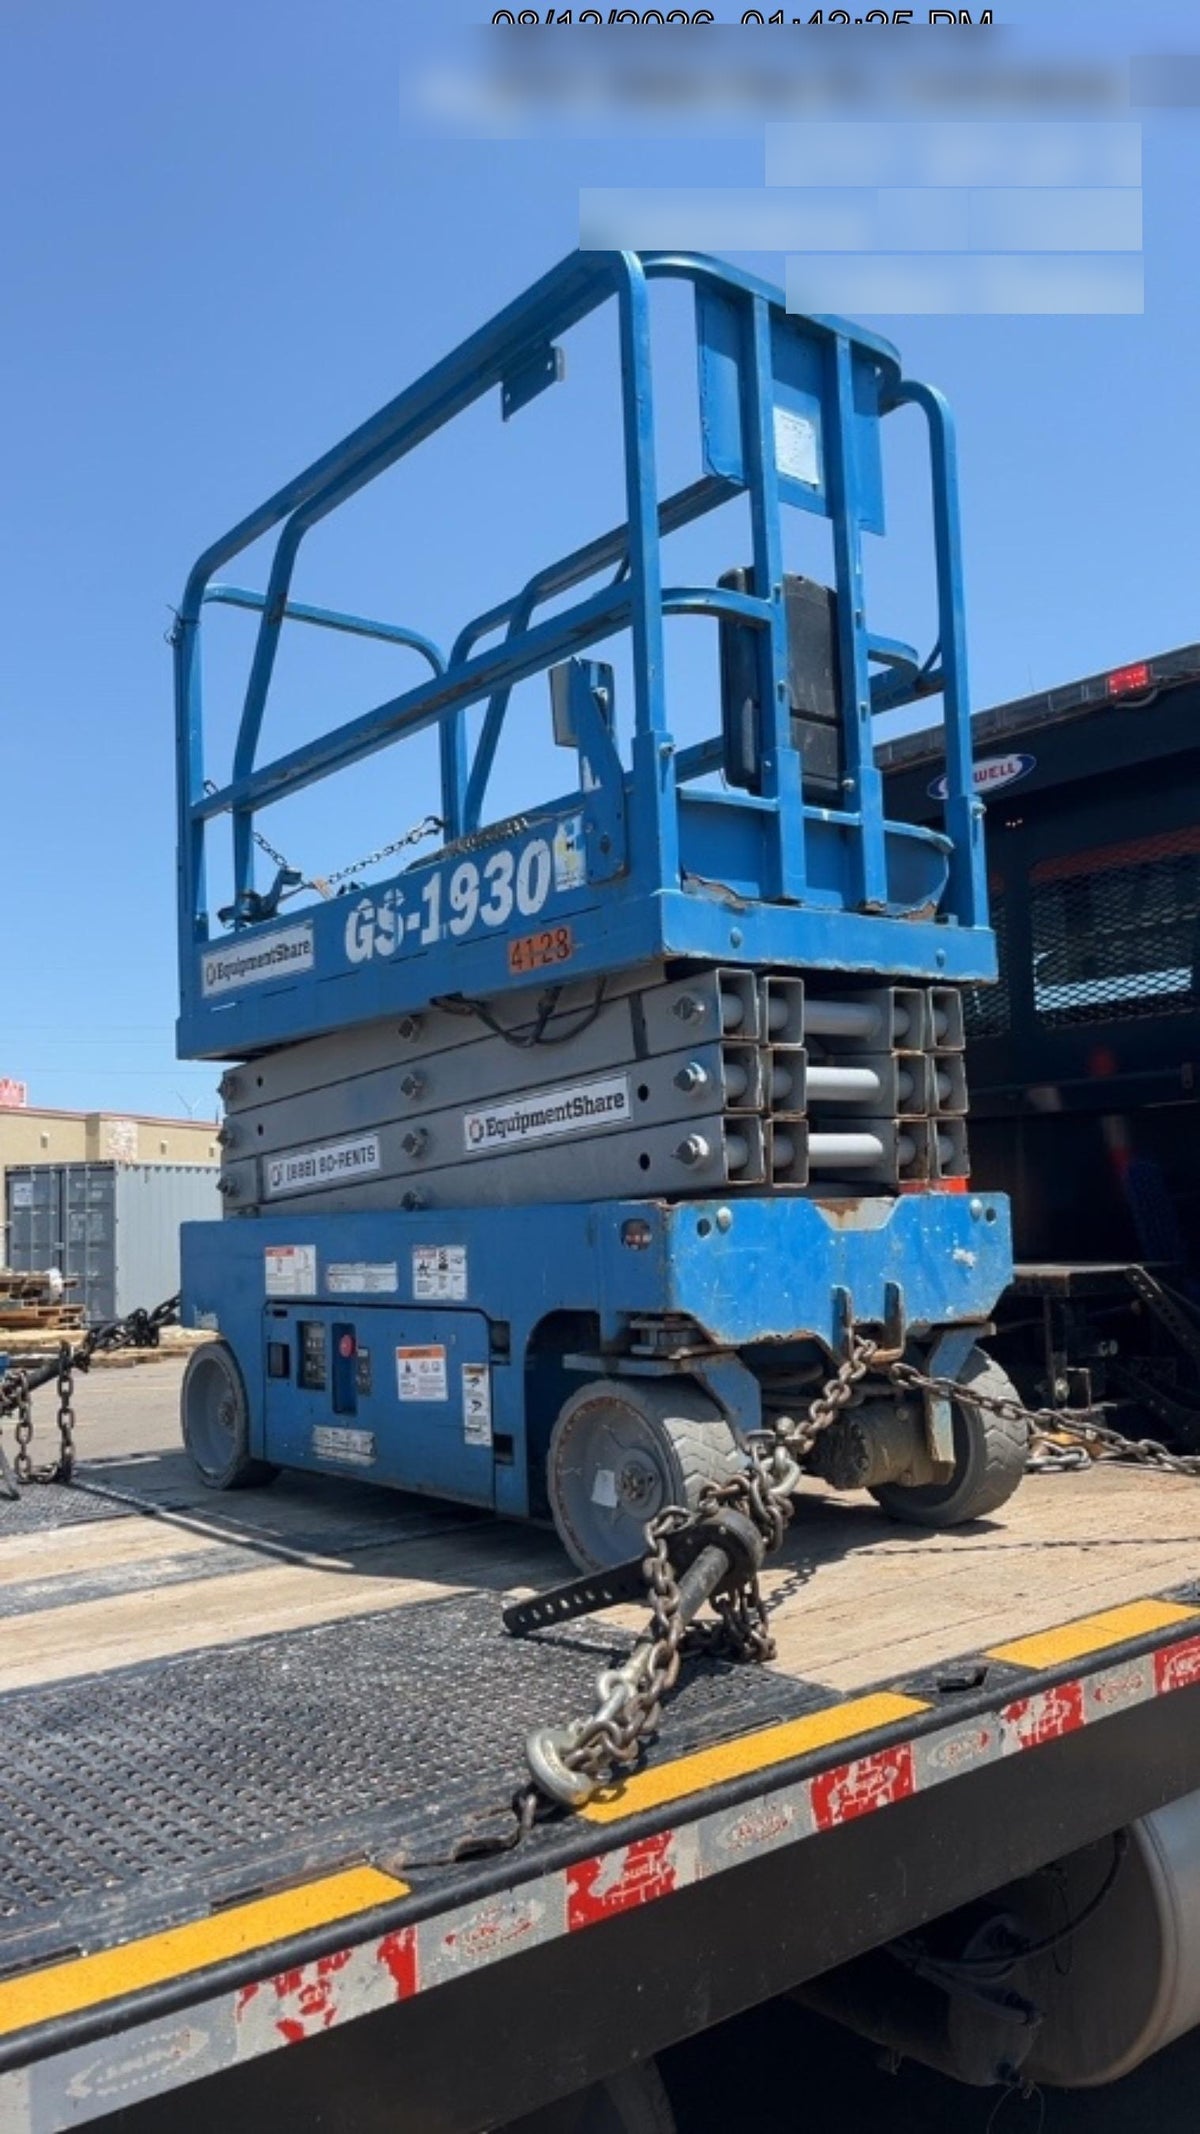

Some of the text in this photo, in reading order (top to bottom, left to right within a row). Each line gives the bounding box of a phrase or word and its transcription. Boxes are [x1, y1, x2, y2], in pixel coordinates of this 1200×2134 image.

[345, 838, 549, 963] GS-1930
[217, 941, 311, 981] EquipmentShare
[485, 1092, 625, 1138] EquipmentShare
